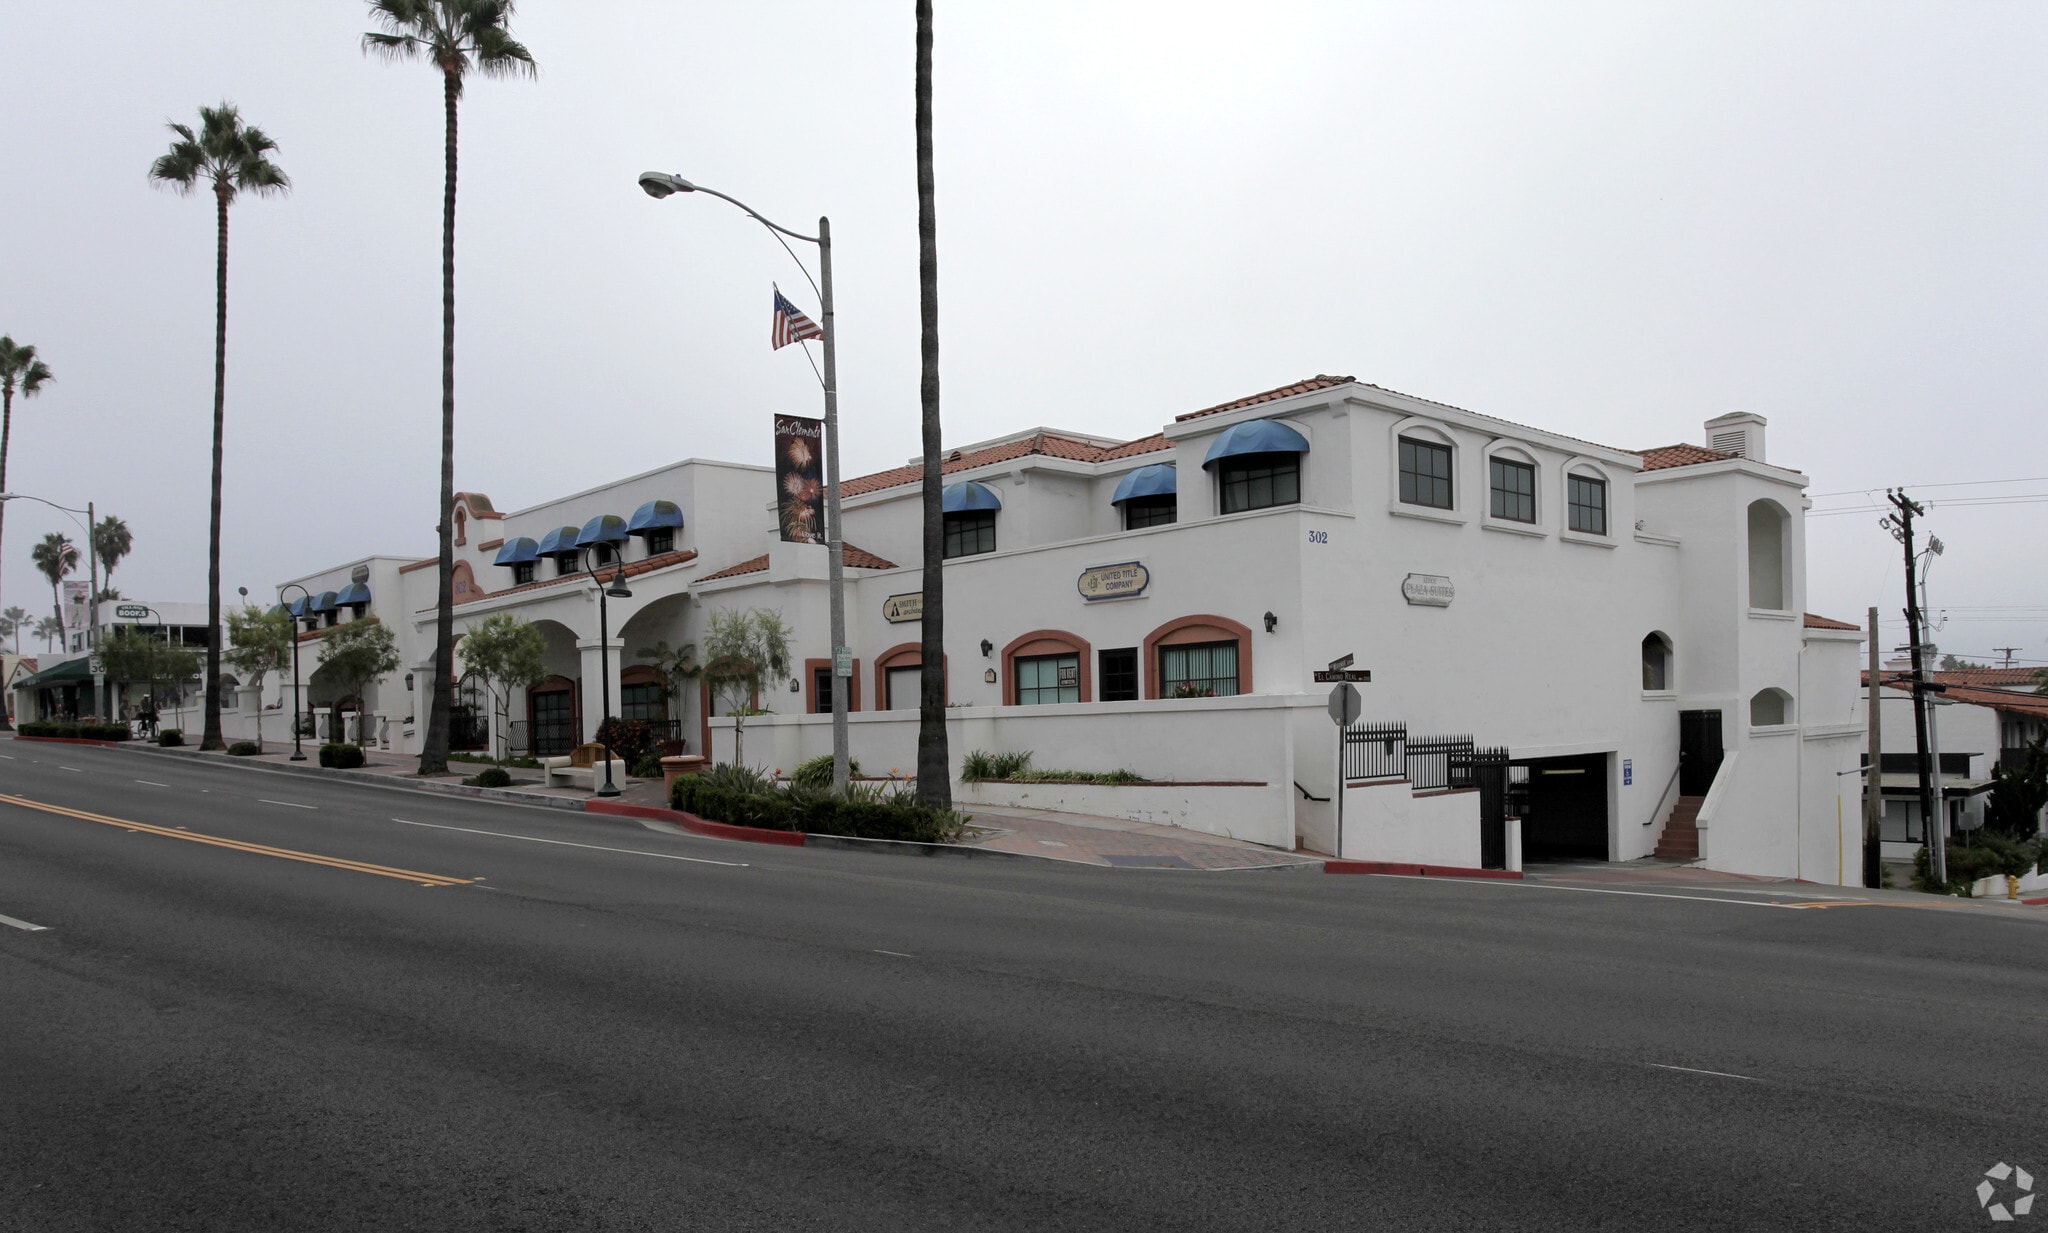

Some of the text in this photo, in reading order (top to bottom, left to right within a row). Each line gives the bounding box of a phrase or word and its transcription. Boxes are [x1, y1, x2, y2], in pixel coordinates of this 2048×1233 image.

[1309, 530, 1328, 544] 302
[1101, 569, 1138, 581] UNITED TITLE
[1106, 580, 1133, 590] COMPANY
[899, 599, 917, 608] SMITH
[91, 665, 106, 673] 30
